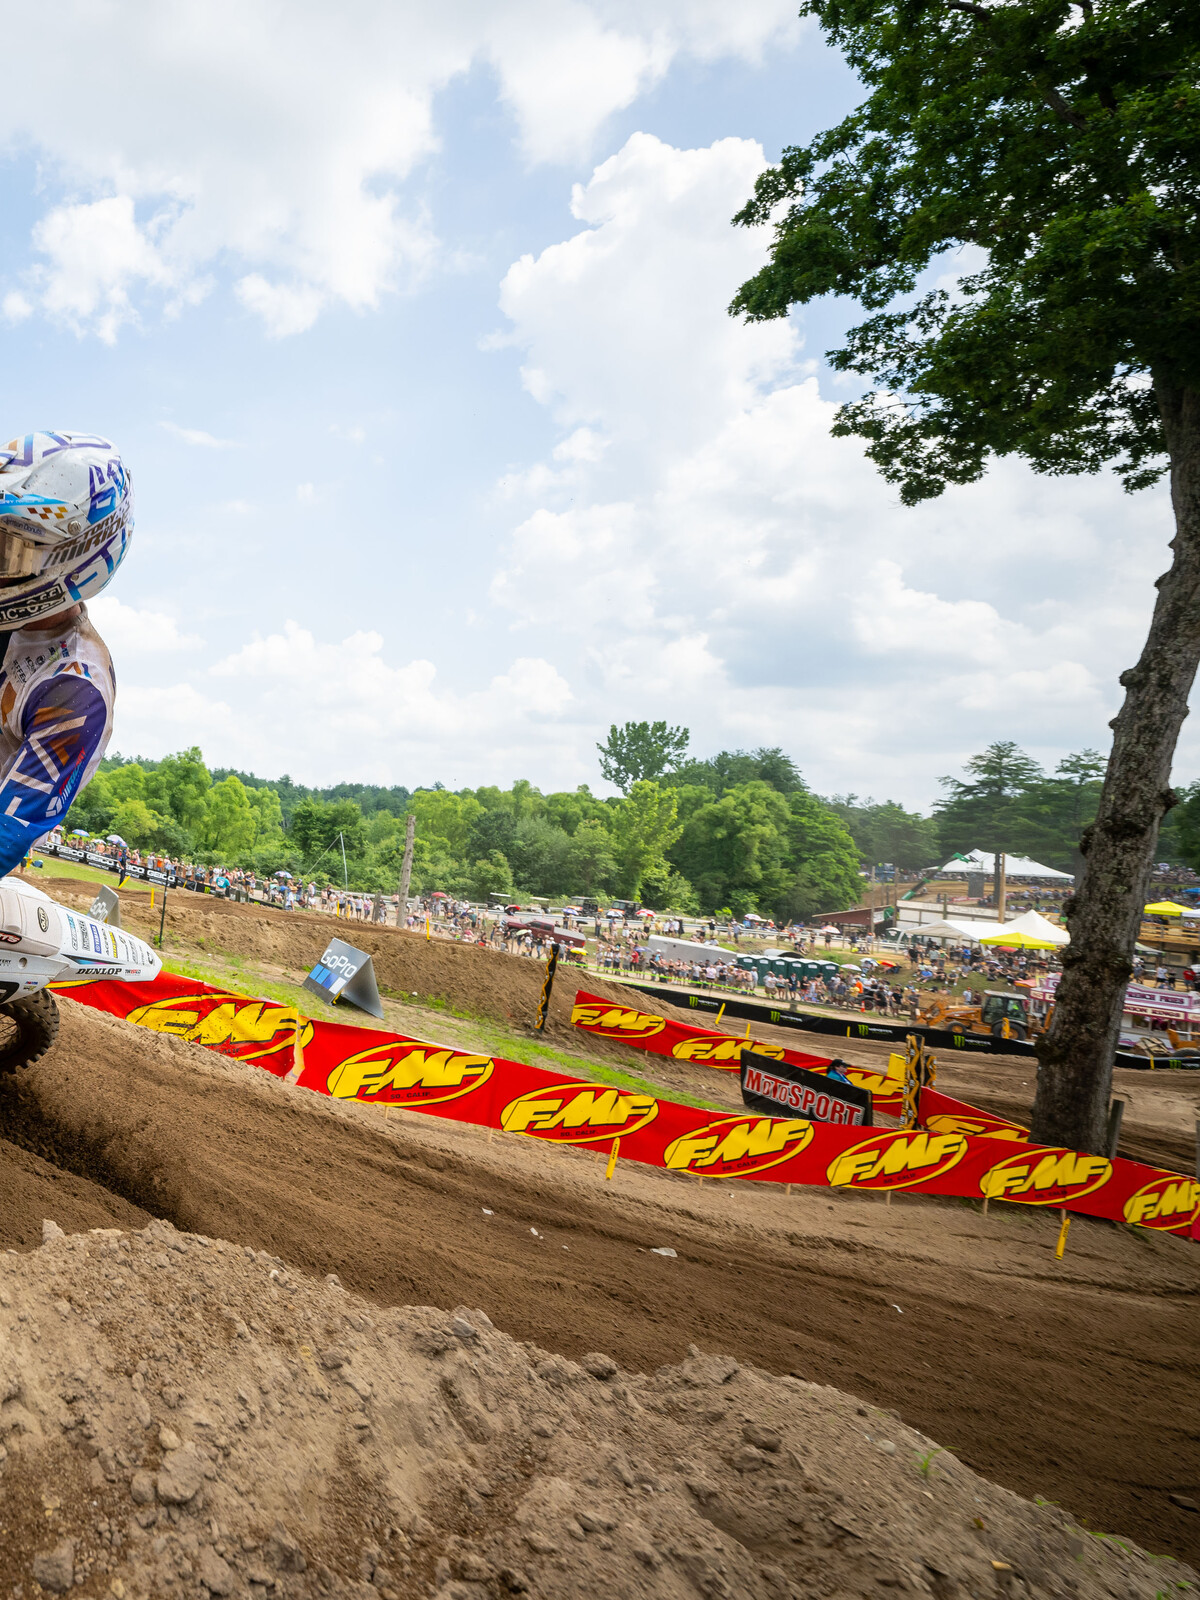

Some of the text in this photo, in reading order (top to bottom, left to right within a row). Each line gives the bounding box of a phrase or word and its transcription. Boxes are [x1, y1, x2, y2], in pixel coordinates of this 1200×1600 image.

[56, 845, 84, 858] GEICO
[147, 869, 176, 882] GEICO
[320, 949, 358, 978] GoPro
[137, 1001, 307, 1046] FMF
[571, 1008, 664, 1031] FMF
[332, 1050, 493, 1098] FMF
[503, 1089, 656, 1132] FMF
[666, 1118, 811, 1169] FMF
[830, 1132, 966, 1187] FMF
[986, 1152, 1110, 1199] FMF
